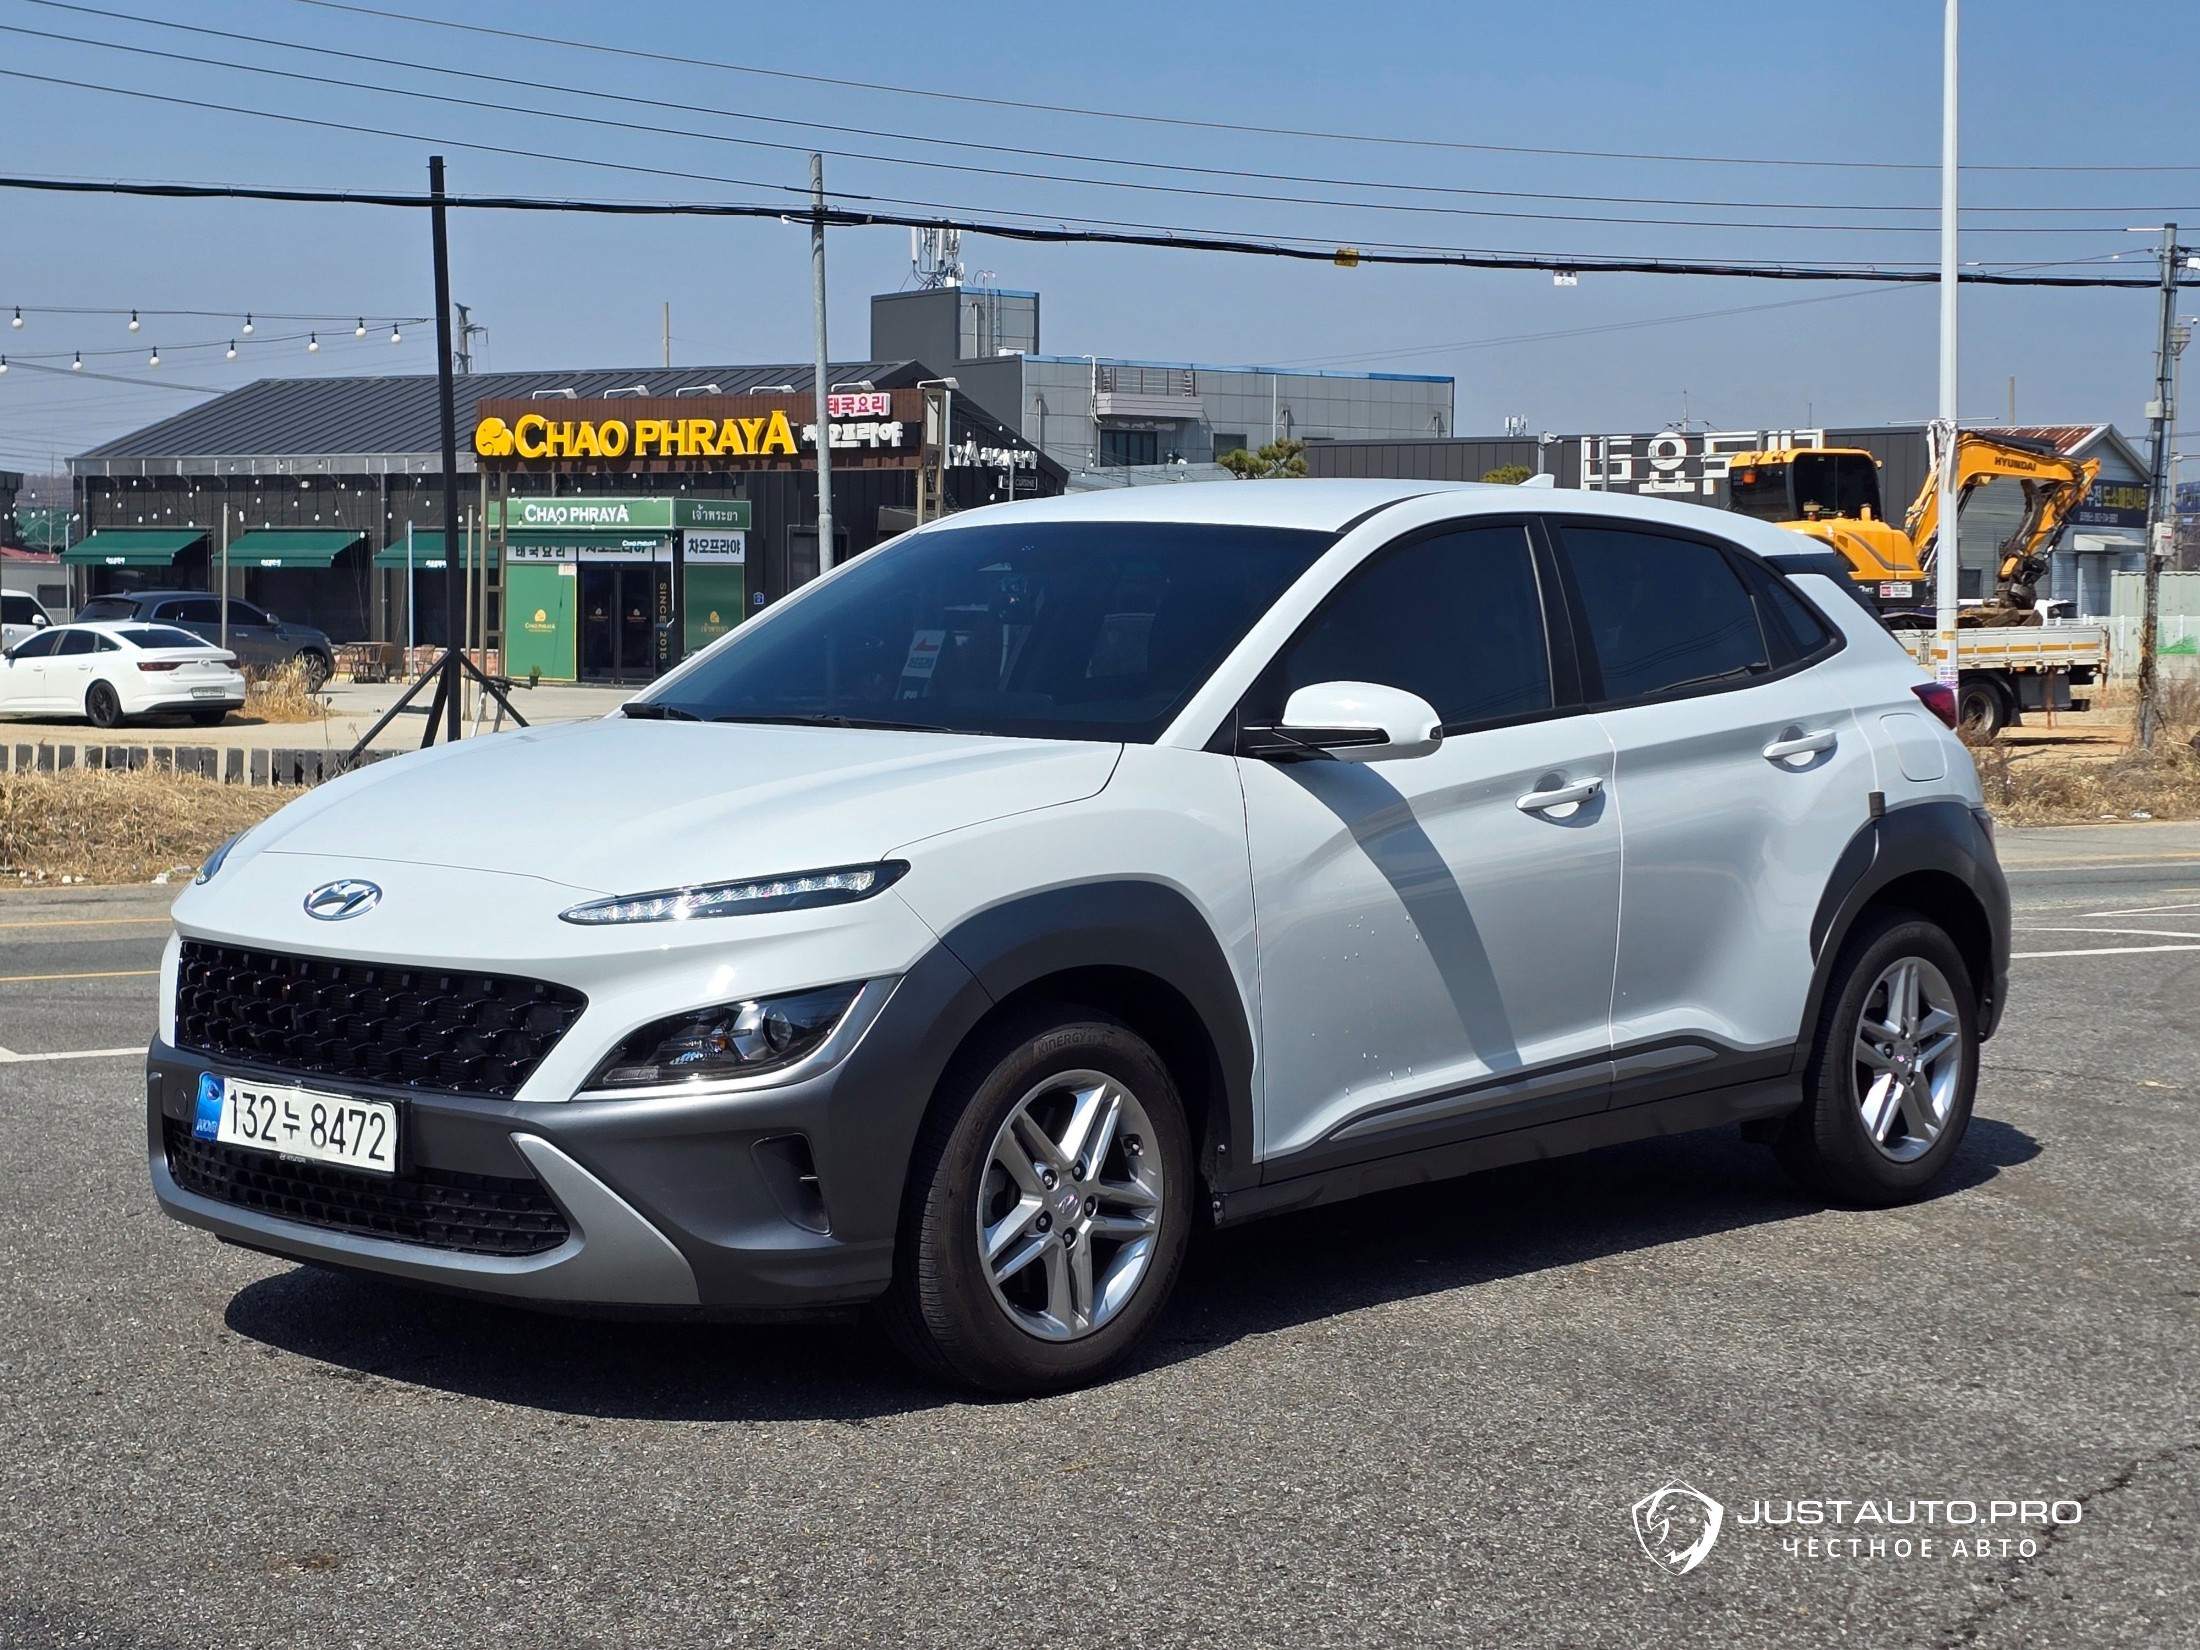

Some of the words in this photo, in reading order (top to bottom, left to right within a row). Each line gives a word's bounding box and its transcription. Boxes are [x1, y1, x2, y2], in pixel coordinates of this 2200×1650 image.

[827, 395, 885, 415] 태국요리
[514, 413, 629, 458] CHAO
[635, 410, 799, 456] PHRAYA
[1994, 456, 2037, 471] HYUNDAI
[524, 504, 567, 522] CHAO
[570, 504, 629, 522] PHRAYA
[692, 504, 738, 521] เจ้าพระยา
[688, 537, 741, 555] 차오프라야
[659, 582, 667, 622] SINCE
[659, 631, 667, 660] 2015
[230, 1089, 300, 1142] 132누
[310, 1103, 386, 1162] 8472
